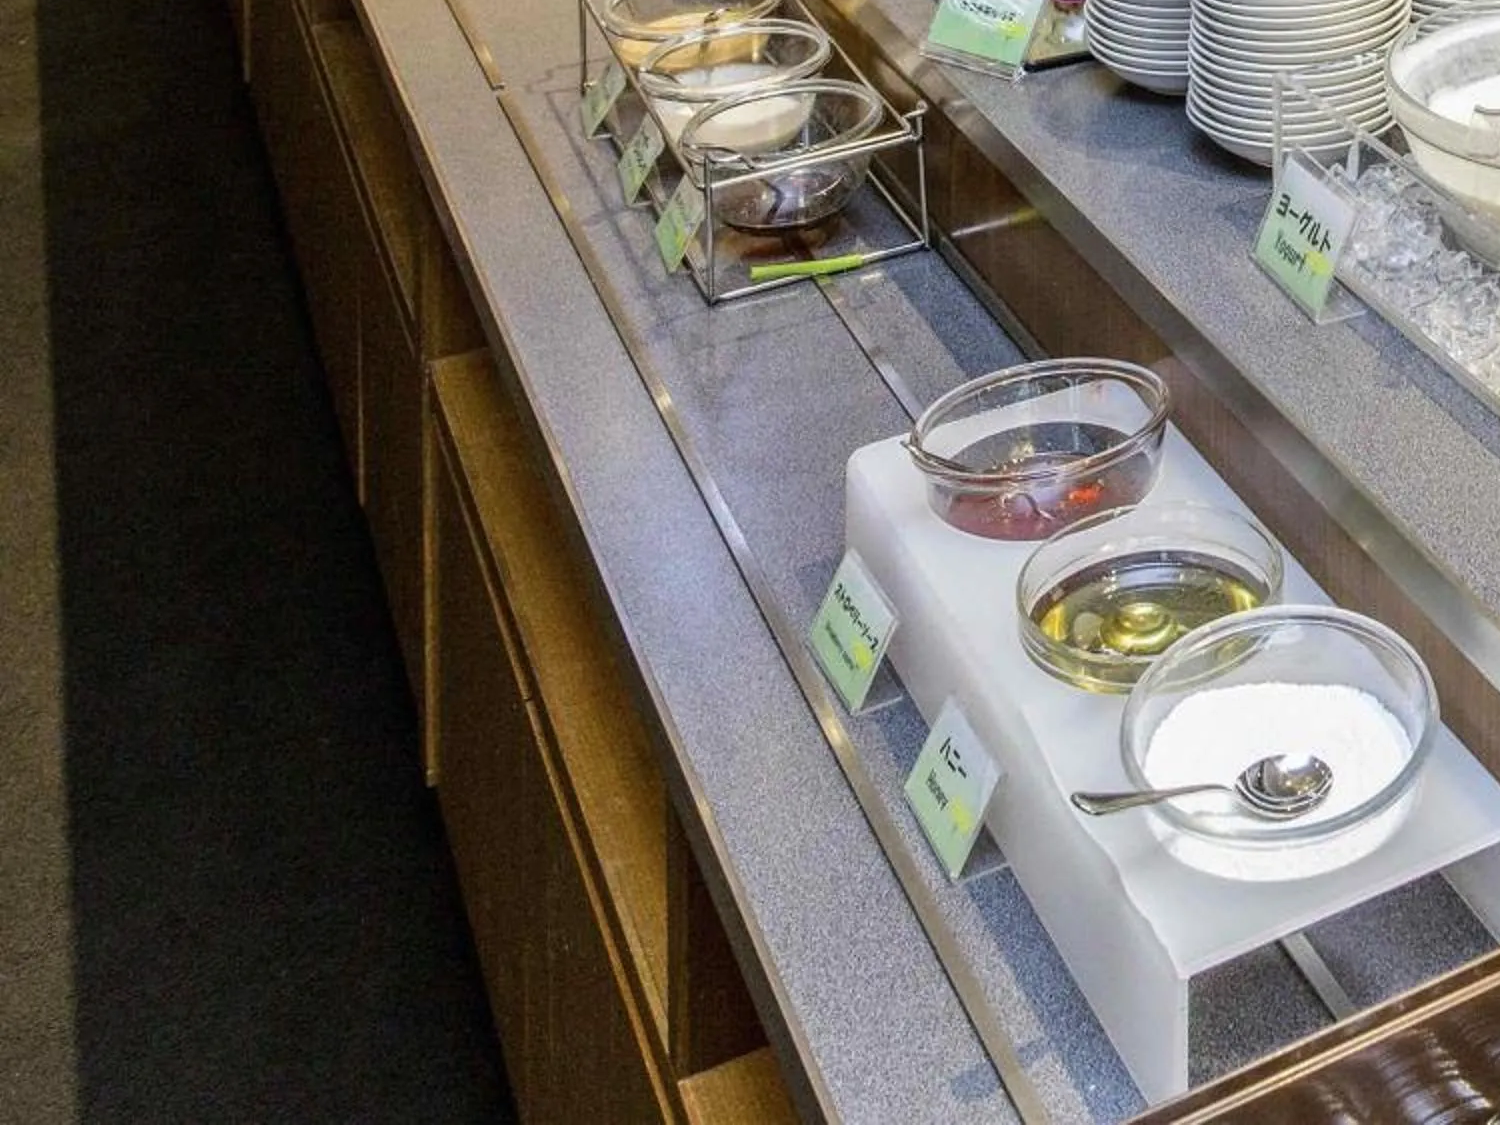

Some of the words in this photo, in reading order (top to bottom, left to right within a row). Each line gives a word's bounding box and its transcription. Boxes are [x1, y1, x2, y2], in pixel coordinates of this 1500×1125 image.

[1275, 193, 1331, 253] ヨーグルト
[939, 736, 968, 779] ハニー
